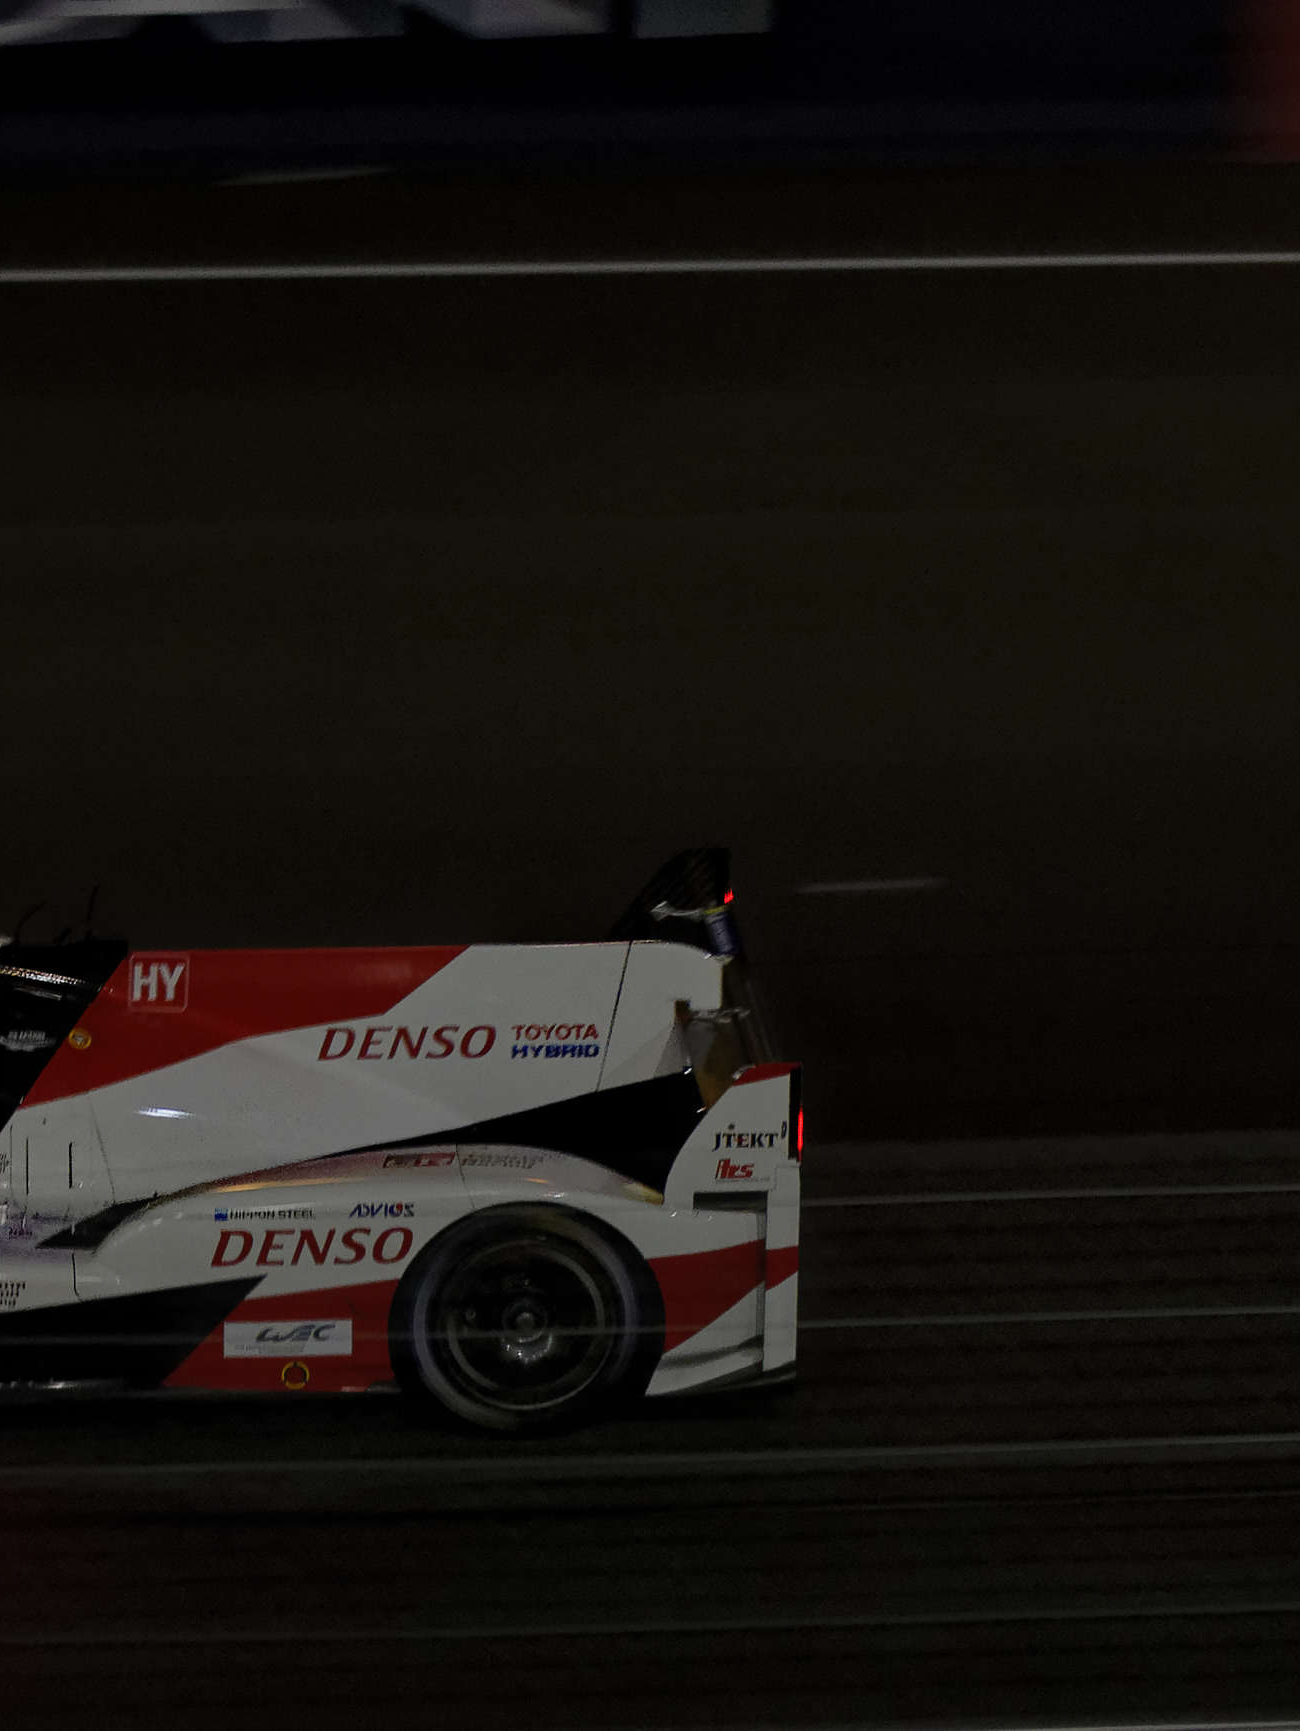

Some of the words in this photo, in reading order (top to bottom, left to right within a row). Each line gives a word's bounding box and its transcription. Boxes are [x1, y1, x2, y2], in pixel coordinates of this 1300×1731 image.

[131, 961, 187, 1003] HY
[511, 1023, 599, 1041] TOYOTA
[318, 1025, 497, 1061] DENSO
[511, 1043, 599, 1059] HYBRID
[712, 1131, 780, 1152] JTEKT
[229, 1209, 275, 1221] NIPPON
[278, 1209, 315, 1221] STEEL
[210, 1226, 414, 1268] DENSO
